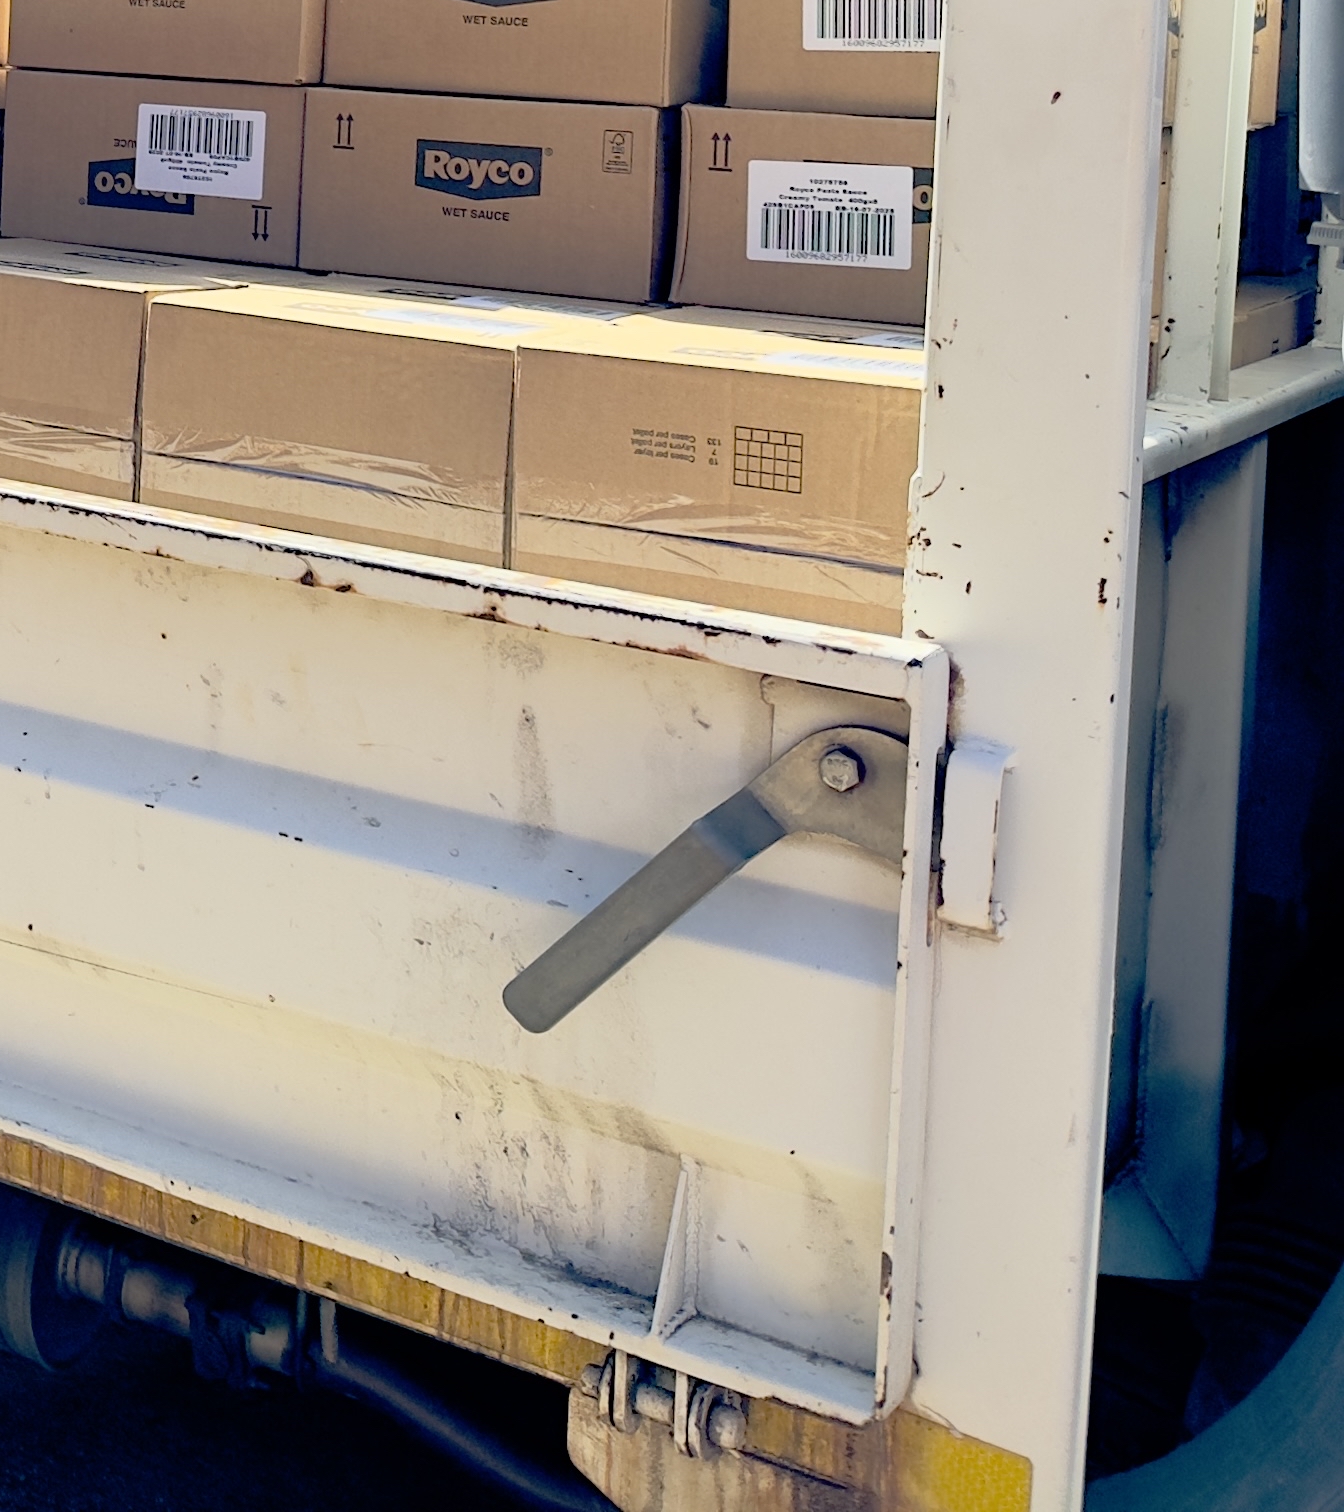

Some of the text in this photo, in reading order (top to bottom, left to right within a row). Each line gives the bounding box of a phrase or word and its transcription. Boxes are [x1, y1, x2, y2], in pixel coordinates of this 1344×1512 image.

[152, 0, 186, 9] SAUCE
[462, 15, 529, 27] WET SAUCE
[424, 149, 534, 190] Royco
[442, 206, 510, 222] WET SAUCE
